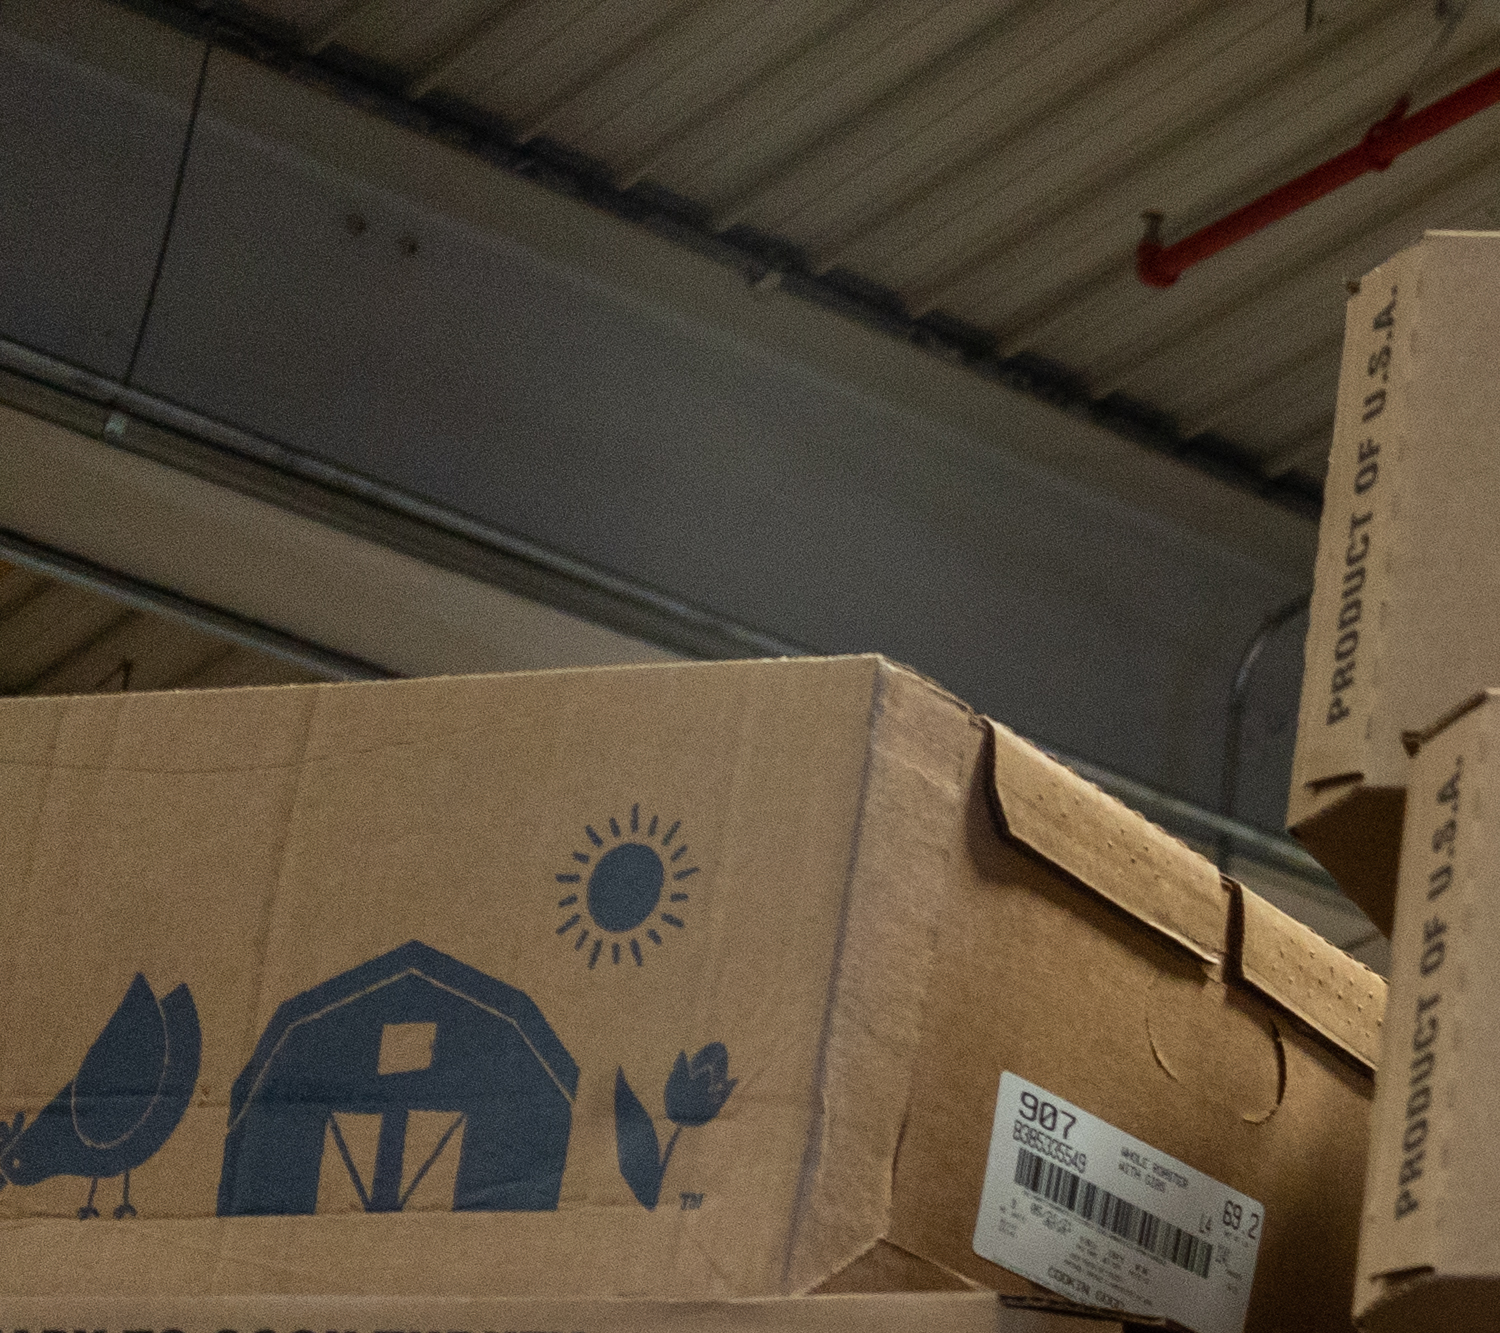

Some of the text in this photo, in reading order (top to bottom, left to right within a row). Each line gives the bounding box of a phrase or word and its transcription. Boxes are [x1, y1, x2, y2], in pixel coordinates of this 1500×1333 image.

[1326, 284, 1399, 727] PRODUCT OF U.S.A.
[1018, 1090, 1077, 1140] 907
[1394, 755, 1464, 1222] PRODUCT OF U.S.A.
